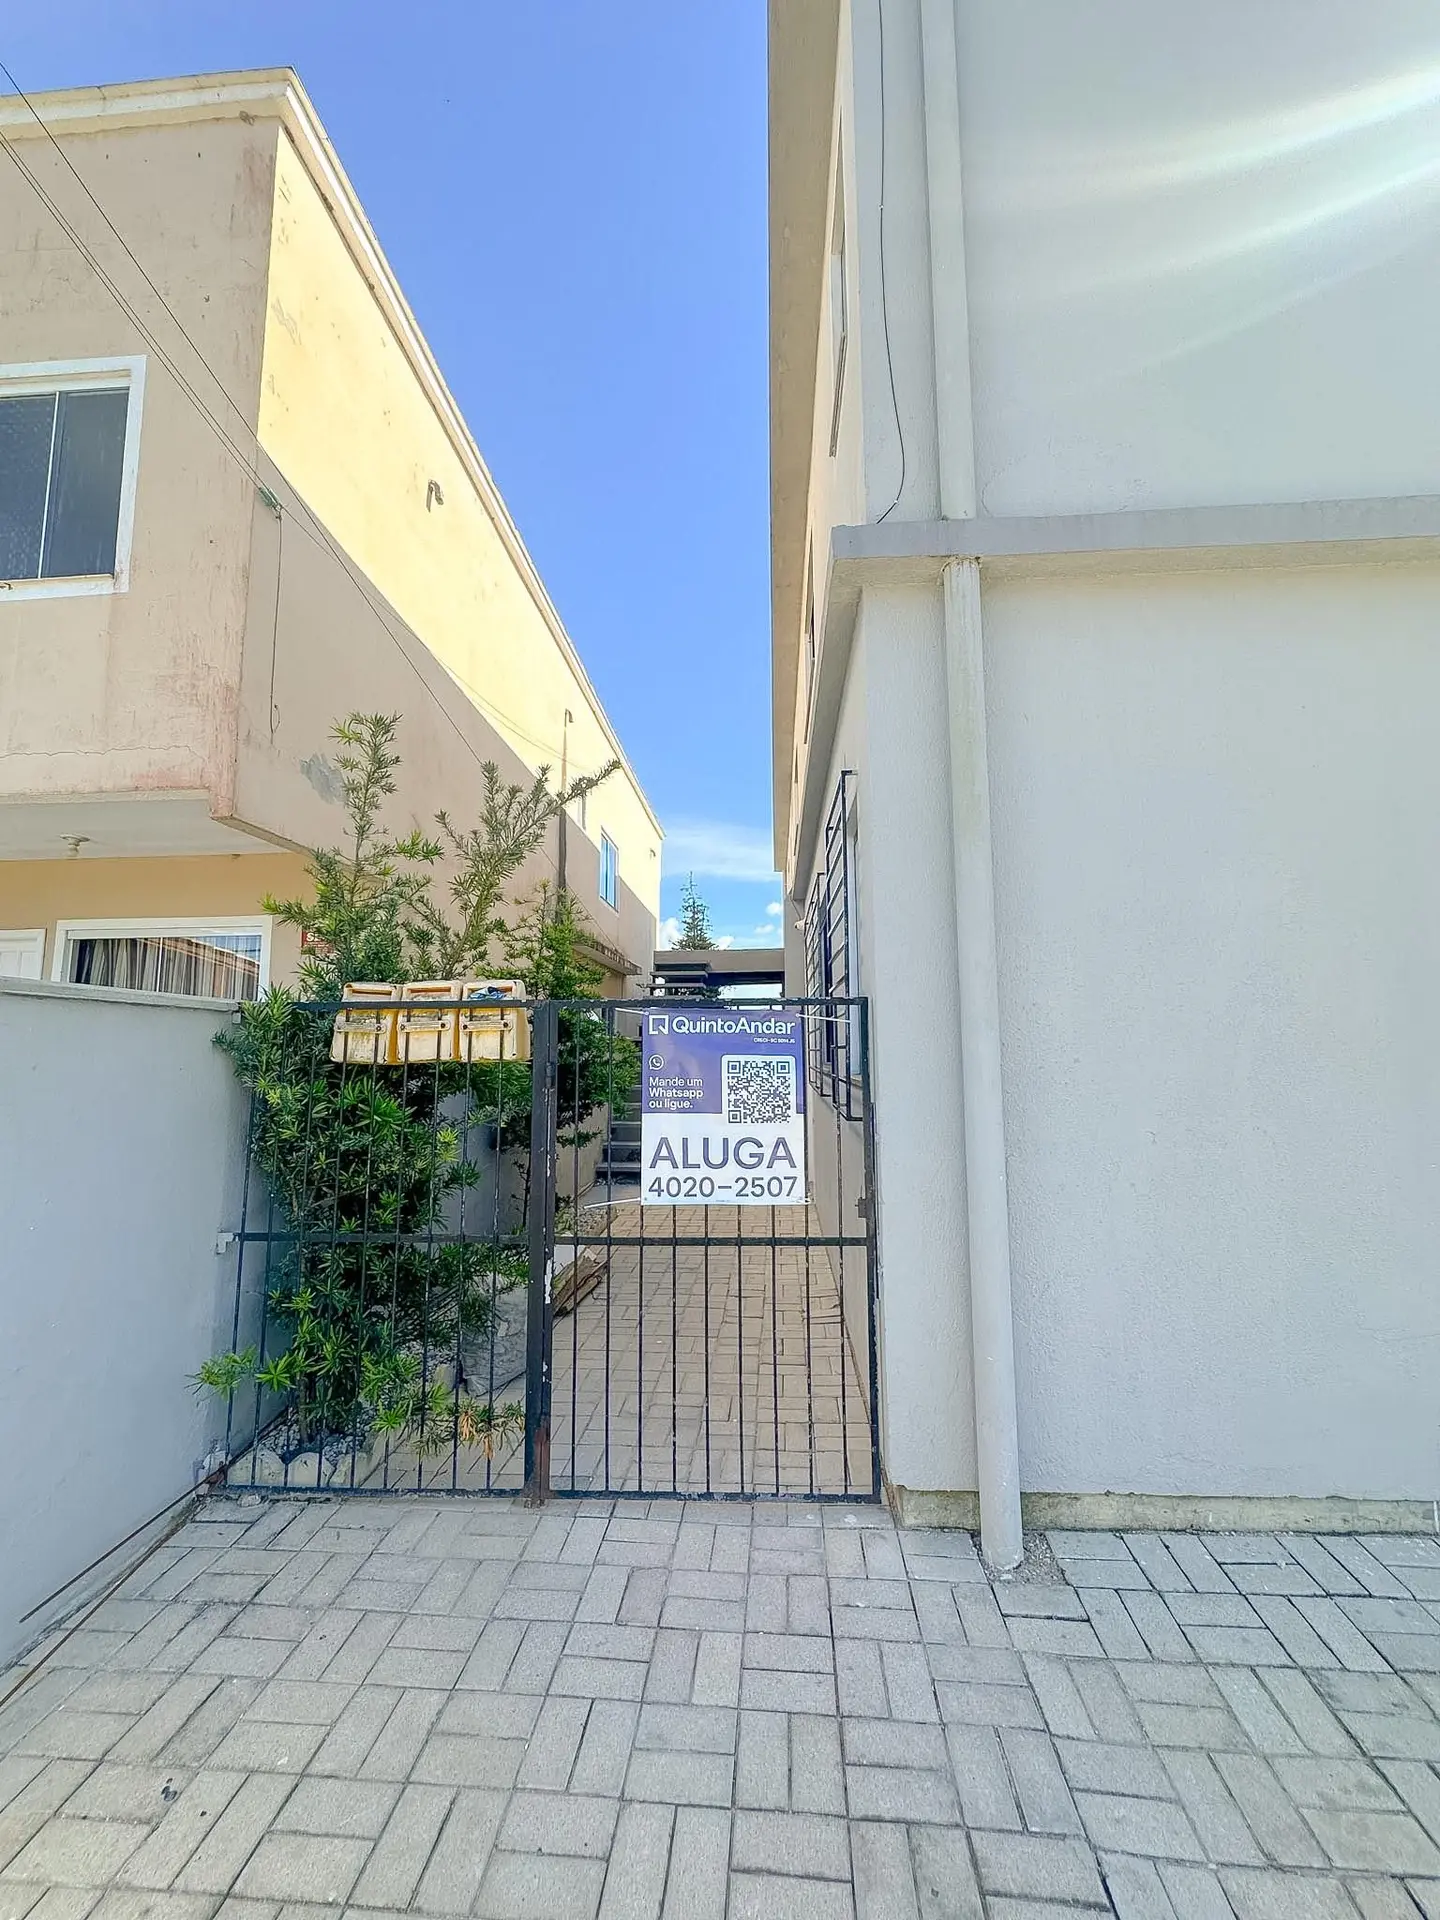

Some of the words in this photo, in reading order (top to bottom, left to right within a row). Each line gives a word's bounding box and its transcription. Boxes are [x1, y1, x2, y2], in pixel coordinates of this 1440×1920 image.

[672, 1016, 795, 1034] QuintoAndar
[649, 1076, 685, 1087] Mande
[686, 1078, 703, 1087] um
[649, 1087, 704, 1099] Whatsapp
[649, 1101, 663, 1109] ou
[664, 1098, 694, 1110] ligue.
[649, 1137, 797, 1169] ALUGA
[649, 1176, 798, 1197] 4020-2507
